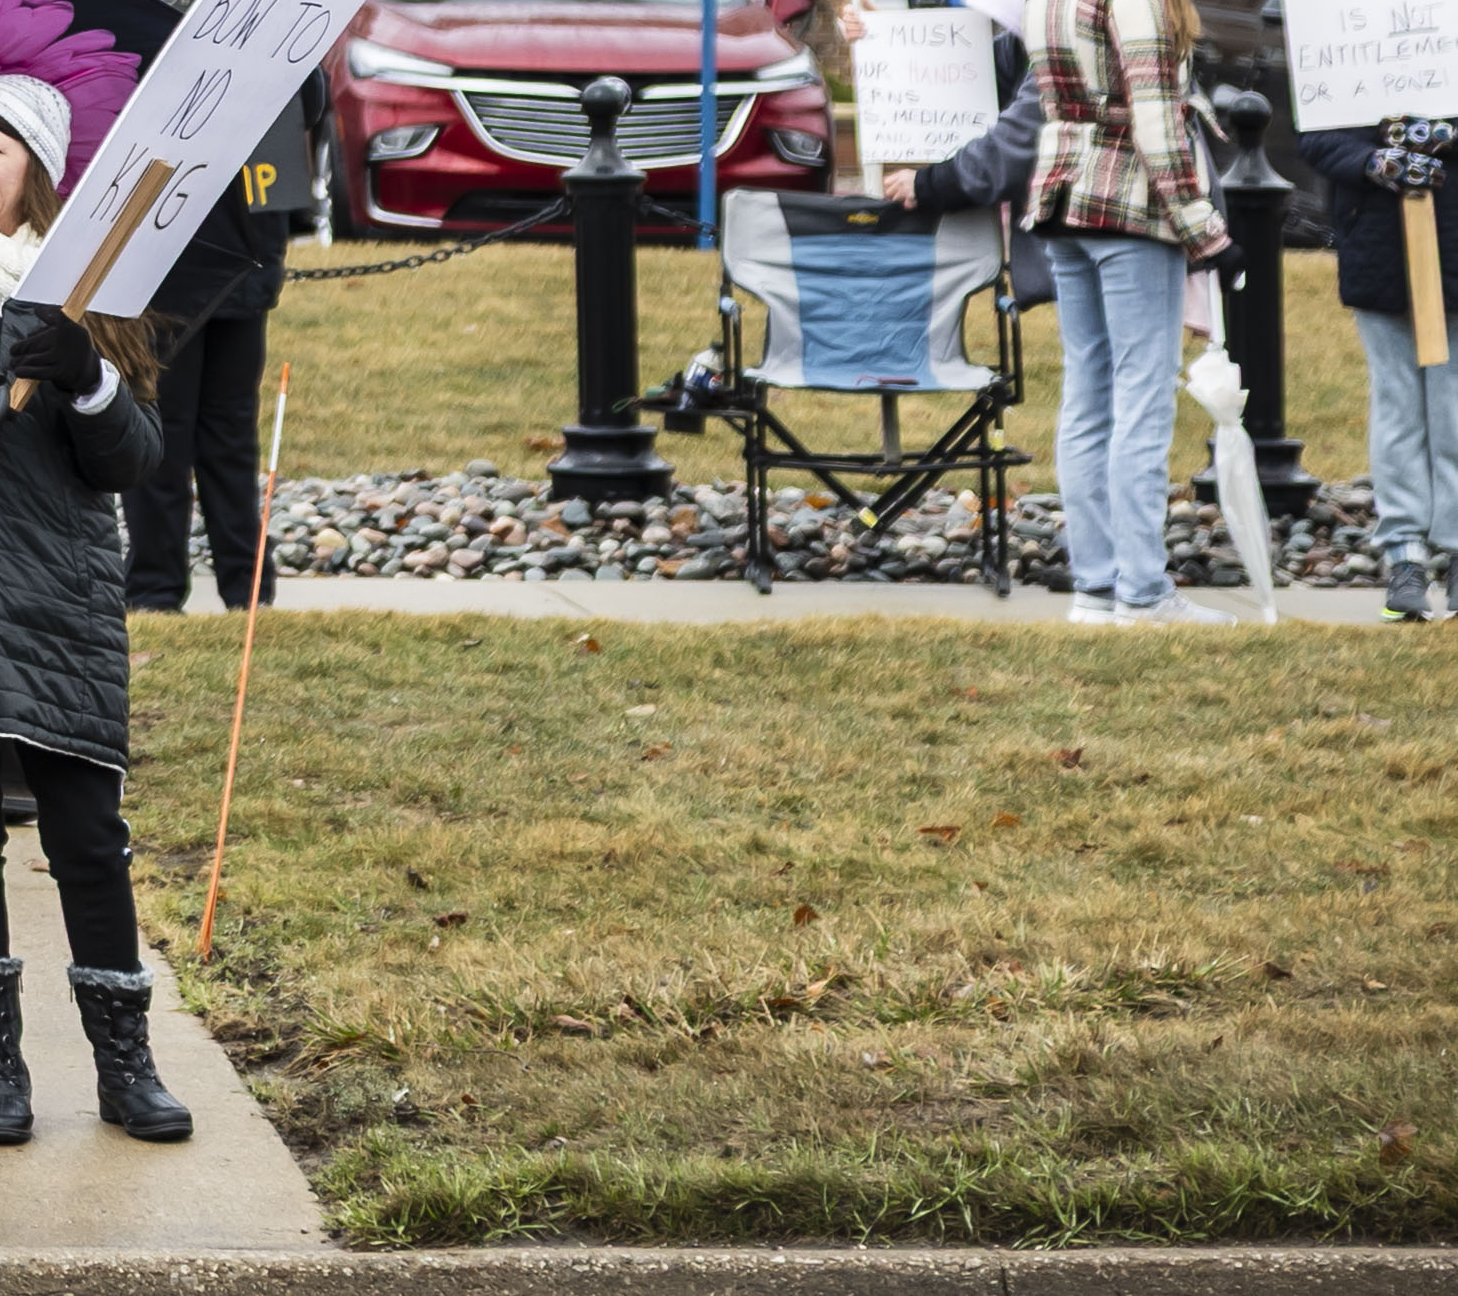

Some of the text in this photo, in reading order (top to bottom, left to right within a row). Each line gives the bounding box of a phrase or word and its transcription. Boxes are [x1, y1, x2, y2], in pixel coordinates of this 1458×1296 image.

[270, 1, 332, 64] TO
[1339, 6, 1368, 34] IS
[890, 22, 972, 48] MUSK
[1353, 79, 1367, 97] A
[160, 68, 233, 141] NO
